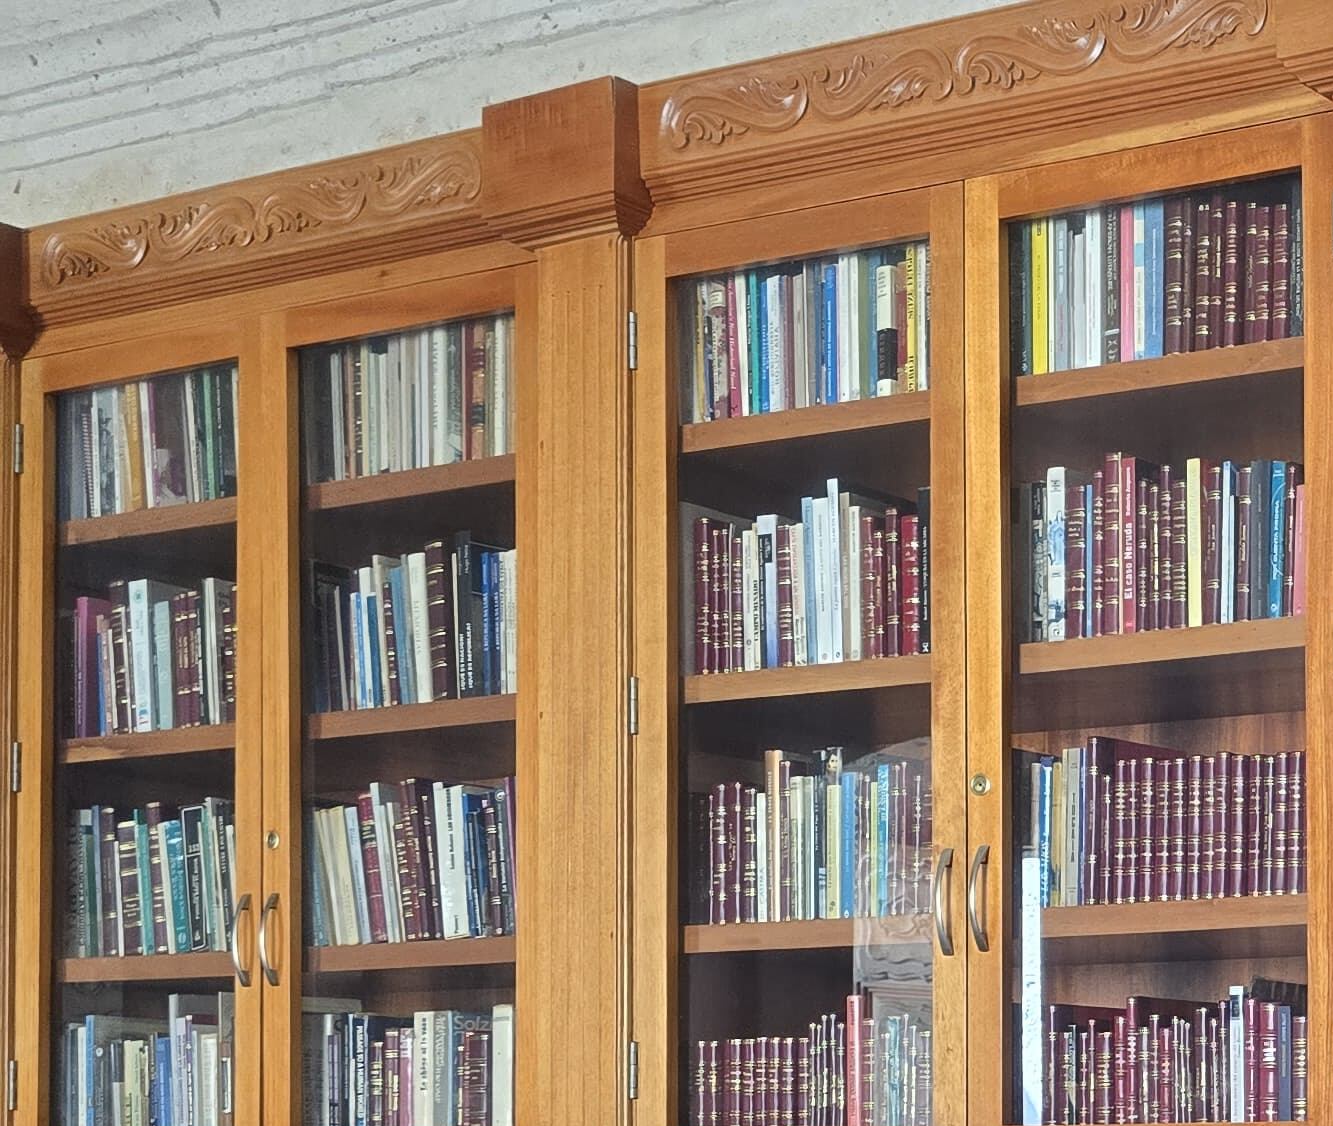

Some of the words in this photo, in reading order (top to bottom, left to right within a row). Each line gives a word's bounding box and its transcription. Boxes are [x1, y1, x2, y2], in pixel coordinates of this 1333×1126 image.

[1123, 521, 1133, 561] Neruda
[1123, 562, 1133, 586] caso
[1123, 587, 1133, 600] El
